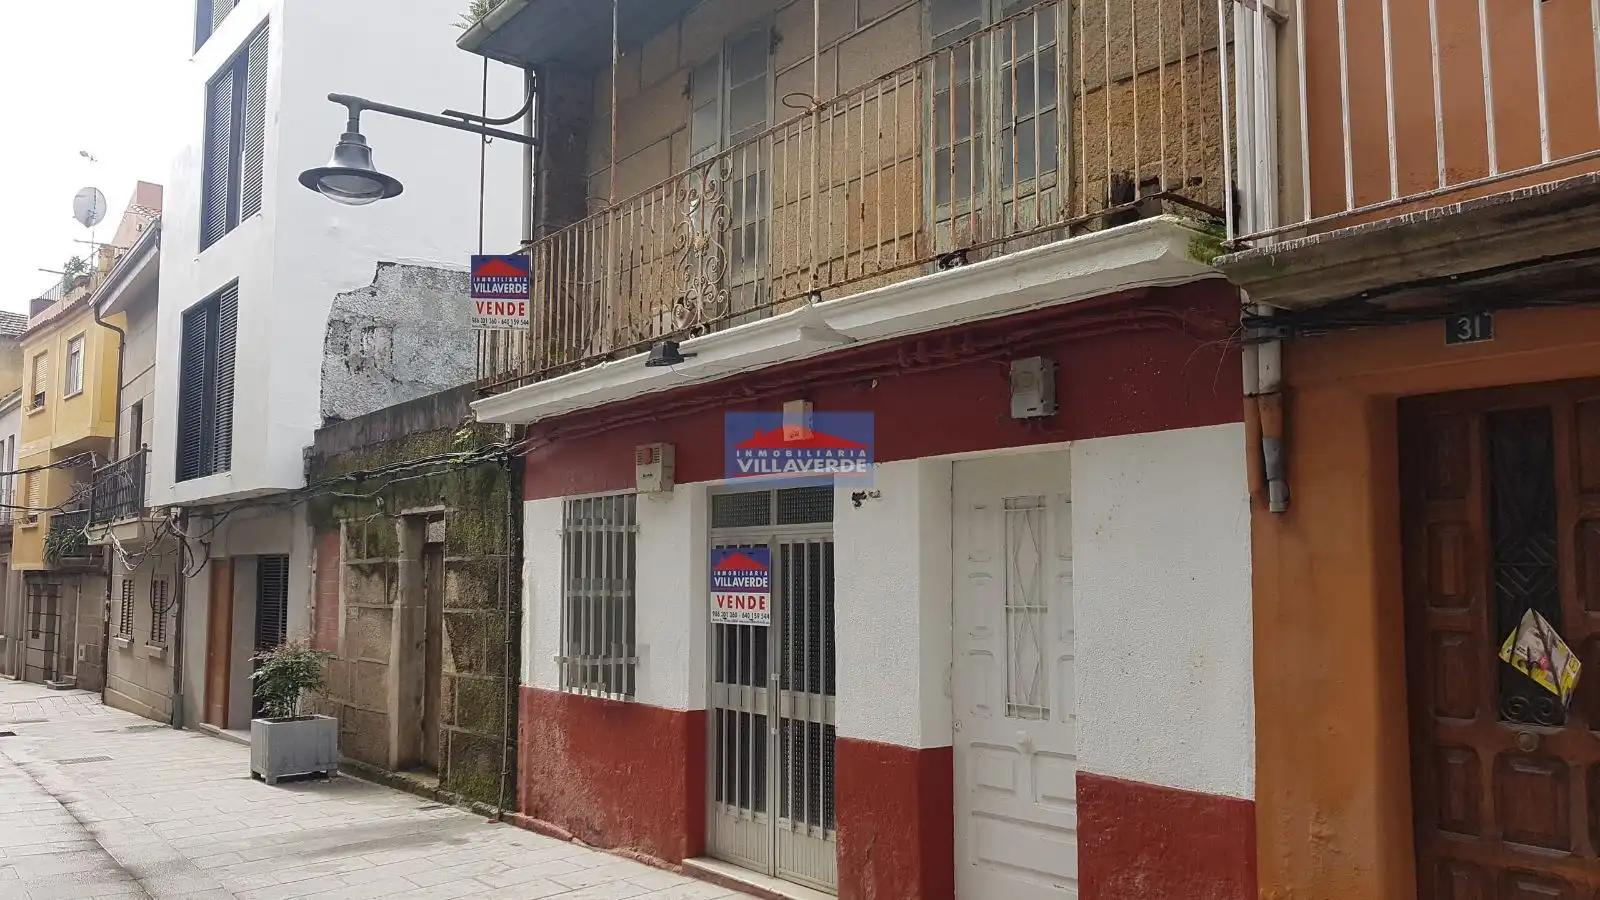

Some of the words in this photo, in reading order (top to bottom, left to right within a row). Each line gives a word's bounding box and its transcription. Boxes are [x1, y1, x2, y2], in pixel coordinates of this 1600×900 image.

[473, 283, 528, 294] VILLAVERDE
[476, 301, 525, 316] VENDE
[1457, 316, 1480, 339] 31
[714, 576, 768, 588] VILLAVERDE
[716, 595, 766, 610] VENDE
